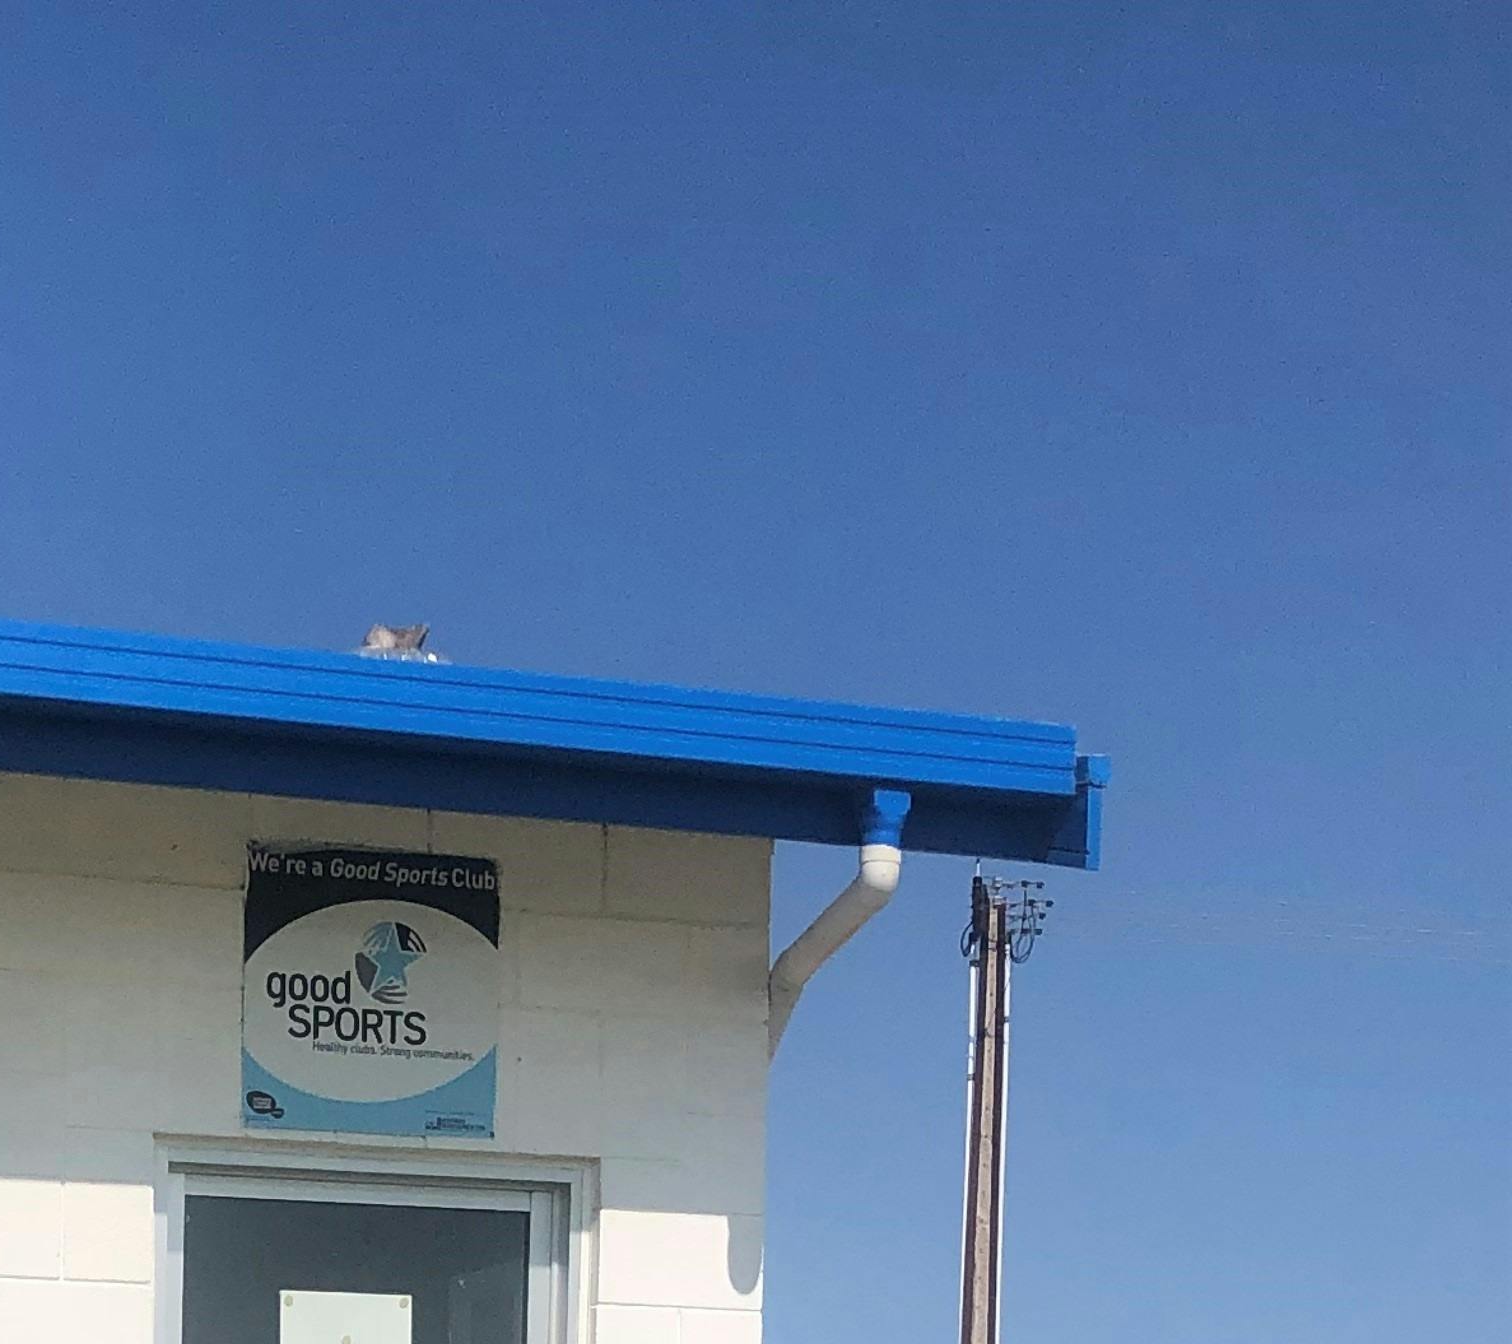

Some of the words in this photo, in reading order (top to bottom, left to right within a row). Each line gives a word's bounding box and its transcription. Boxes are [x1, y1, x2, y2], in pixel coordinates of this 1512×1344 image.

[249, 852, 306, 874] We're
[311, 861, 324, 877] a
[330, 858, 380, 880] Good
[384, 863, 449, 887] Sports
[451, 868, 496, 890] Club
[266, 971, 351, 1008] good
[288, 1004, 427, 1046] SPORTS
